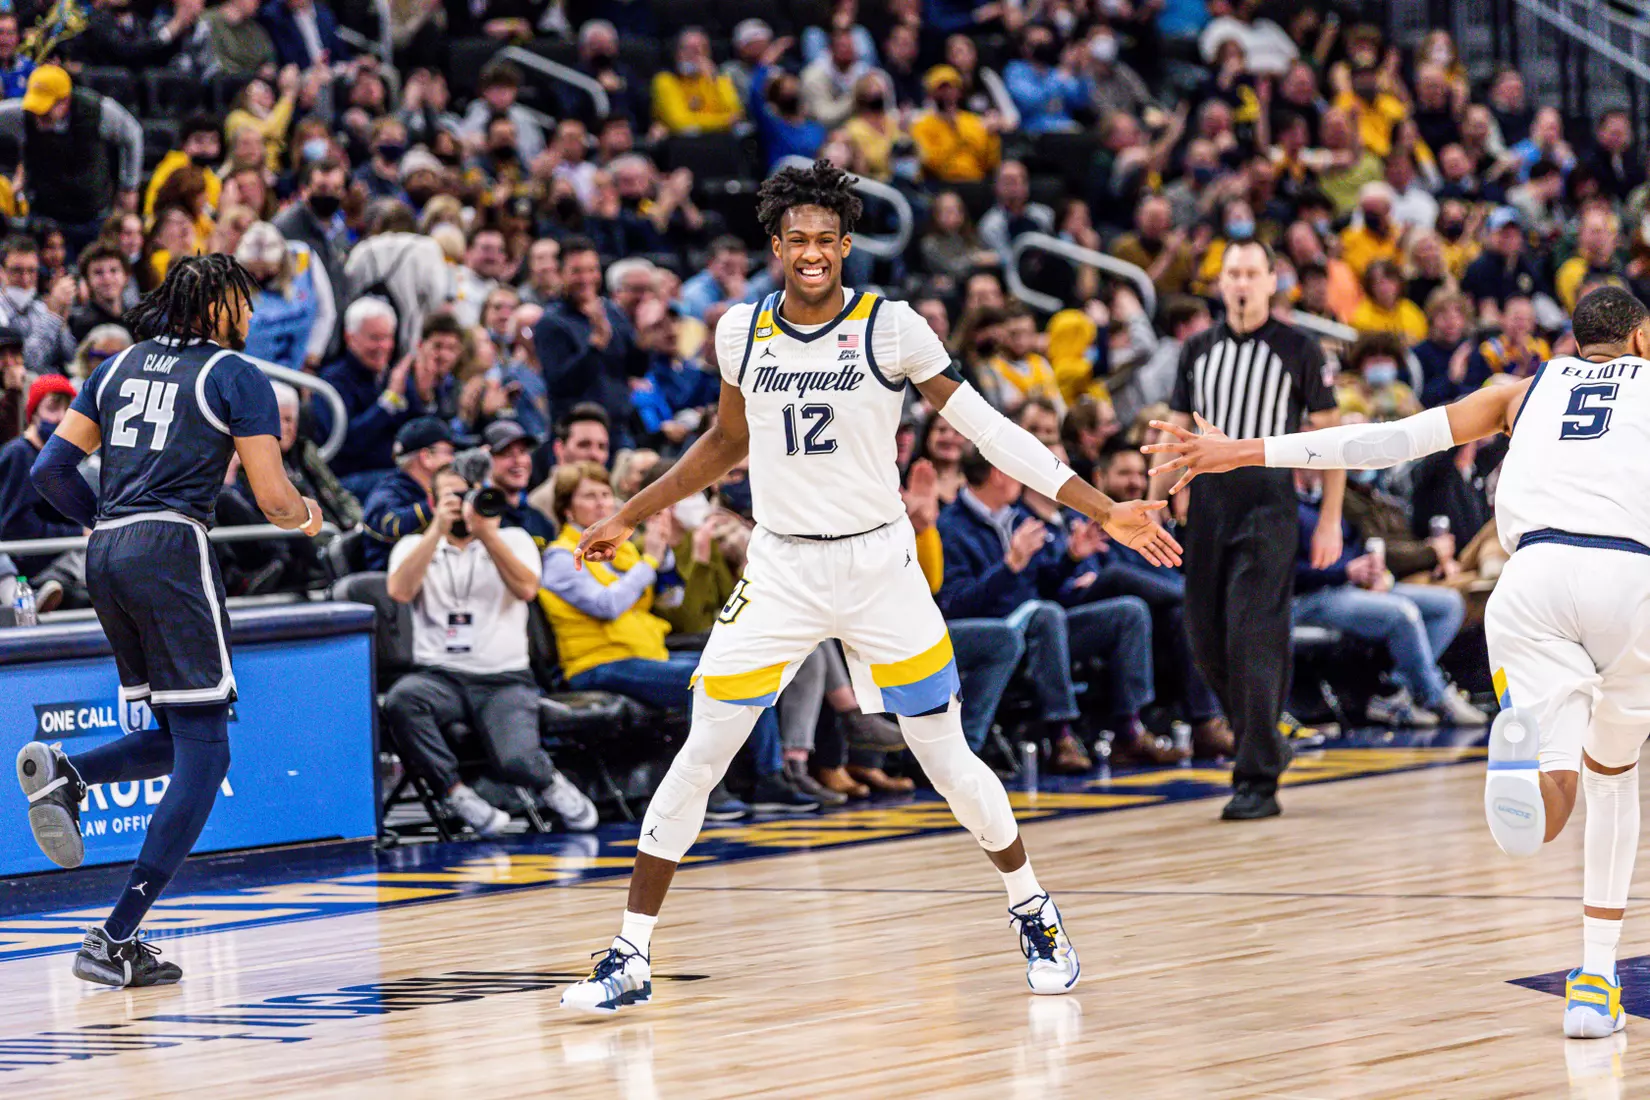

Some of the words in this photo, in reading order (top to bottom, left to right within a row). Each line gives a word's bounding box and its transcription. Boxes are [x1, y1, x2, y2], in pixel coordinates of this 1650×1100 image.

[143, 353, 180, 375] CLARK
[837, 353, 861, 361] EAST
[1561, 363, 1643, 380] ELLIOTT
[752, 364, 865, 398] Marquette
[110, 378, 179, 451] 24
[1558, 382, 1620, 440] 5
[782, 403, 838, 456] 12
[41, 708, 75, 733] ONE
[77, 705, 118, 730] CALL
